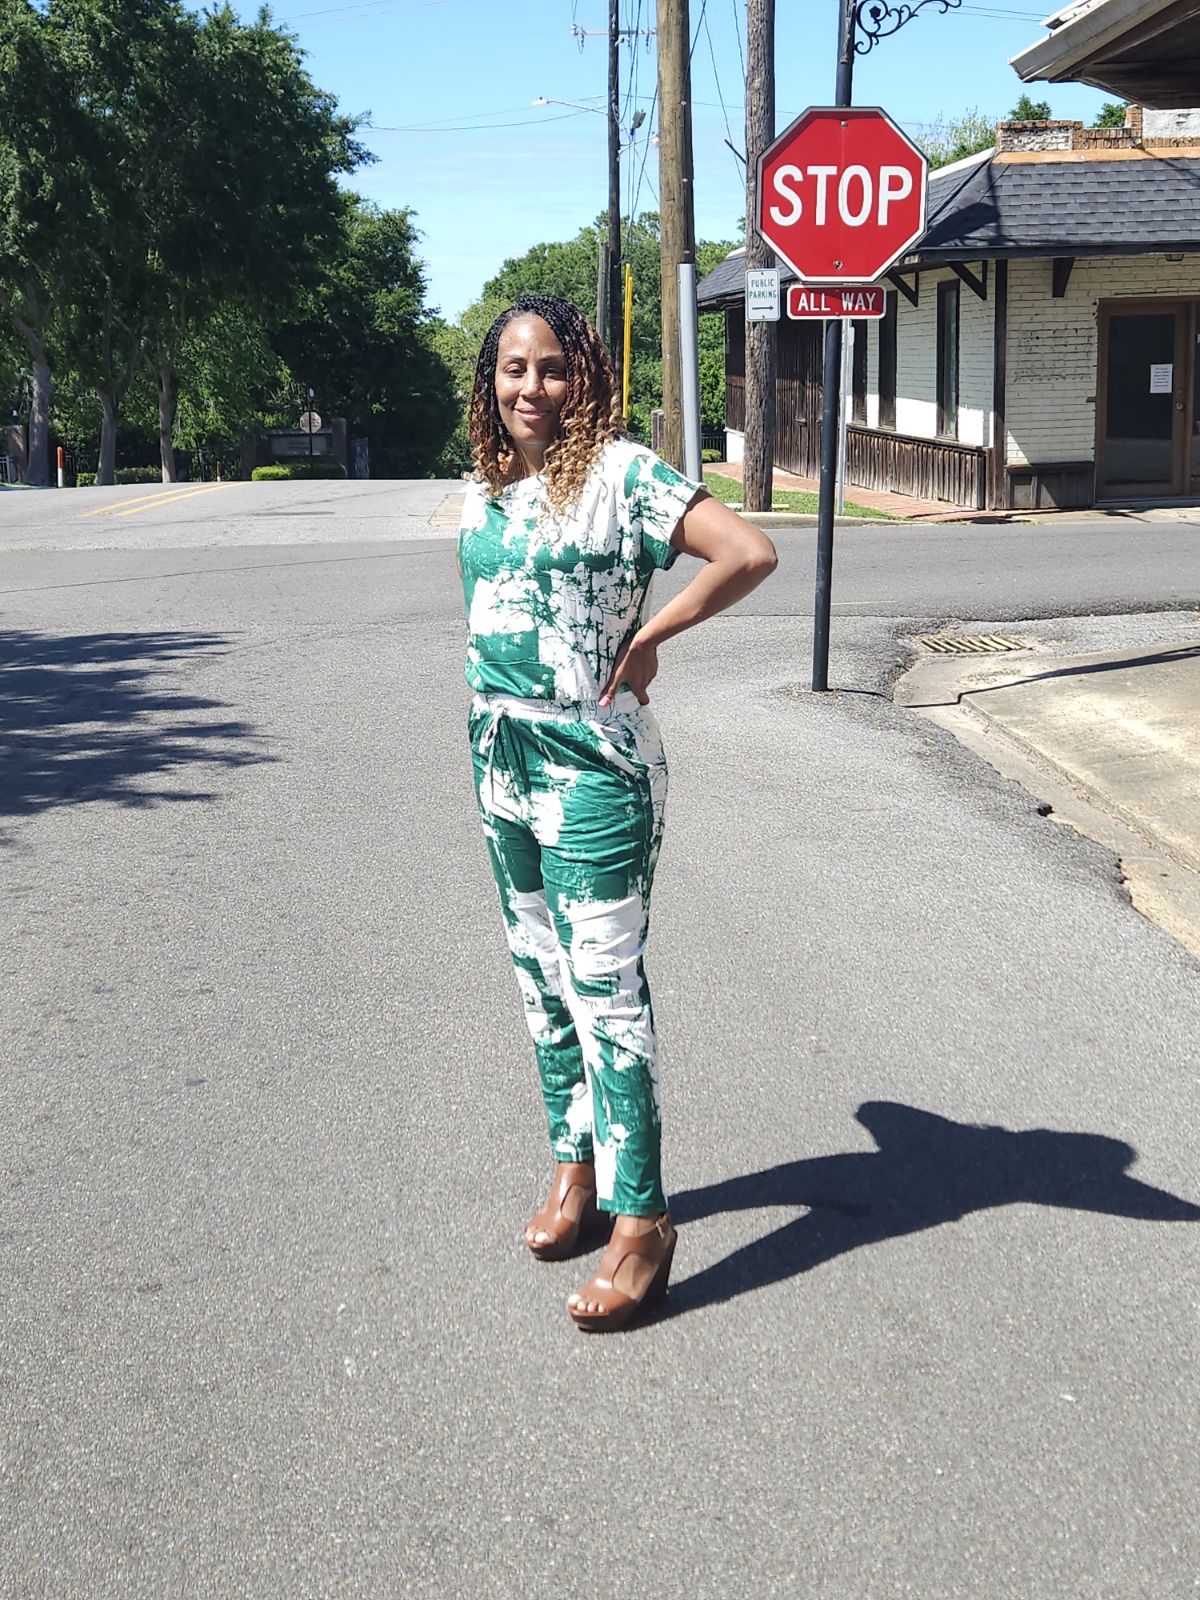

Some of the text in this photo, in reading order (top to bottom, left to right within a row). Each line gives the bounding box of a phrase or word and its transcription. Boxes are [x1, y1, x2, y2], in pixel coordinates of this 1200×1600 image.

[769, 164, 913, 227] STOP
[751, 279, 774, 287] PUBLIC
[749, 290, 777, 299] PARKING
[797, 292, 876, 311] ALL WAY
